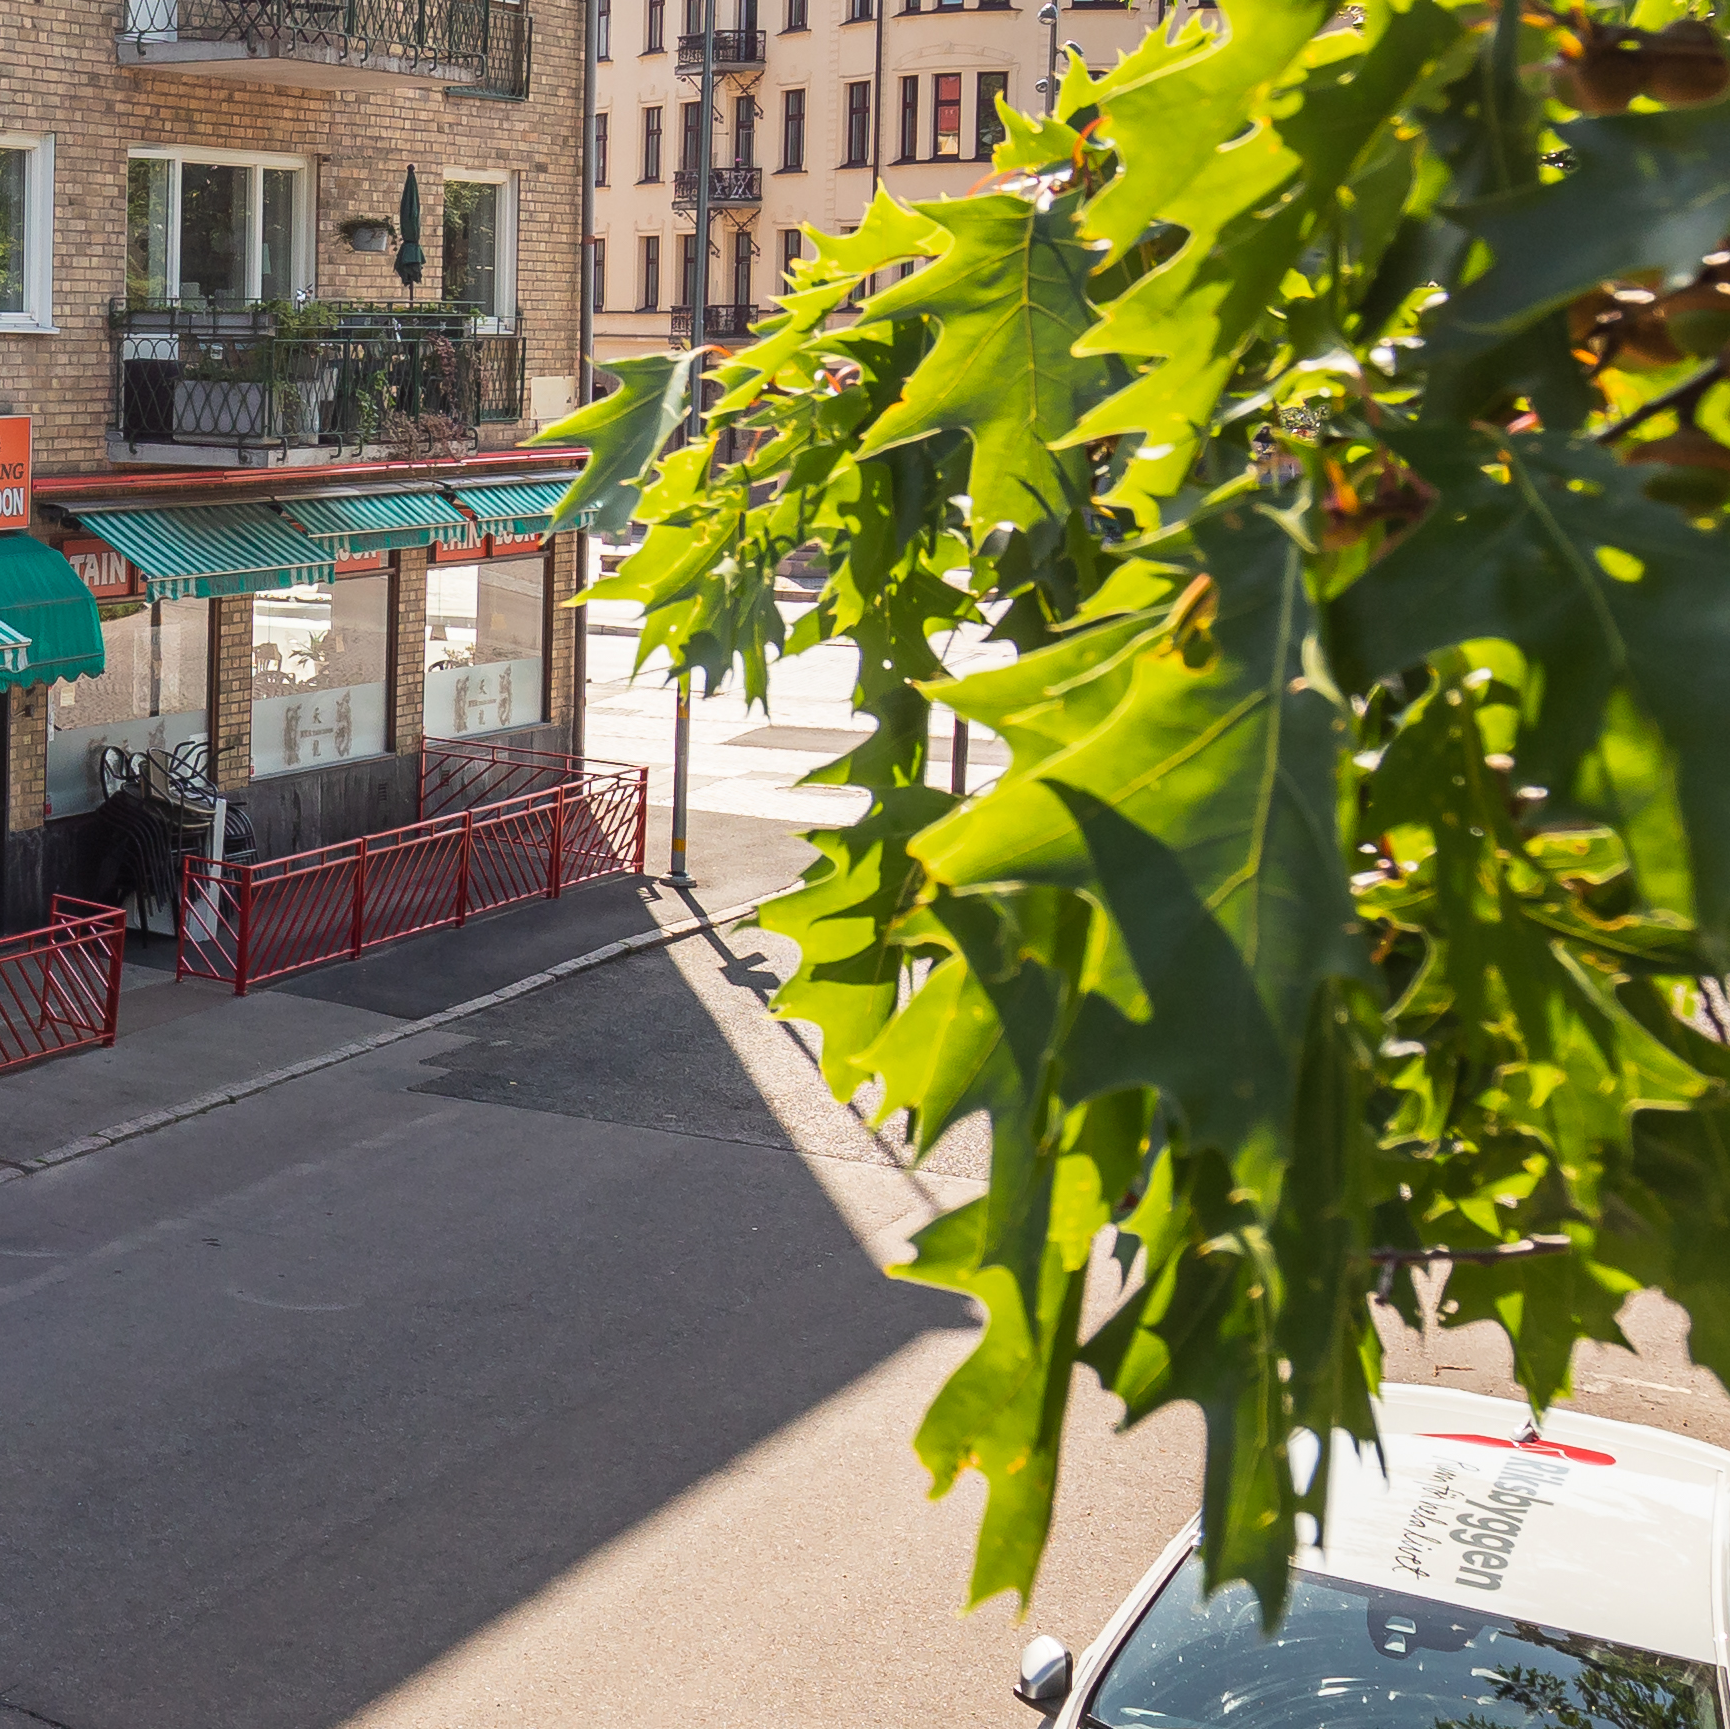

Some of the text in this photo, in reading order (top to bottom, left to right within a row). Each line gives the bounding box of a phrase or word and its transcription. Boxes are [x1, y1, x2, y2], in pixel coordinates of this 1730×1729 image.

[68, 551, 127, 587] TAIN
[1448, 1456, 1571, 1591] Riksbyggen
[1391, 1527, 1443, 1581] livet
